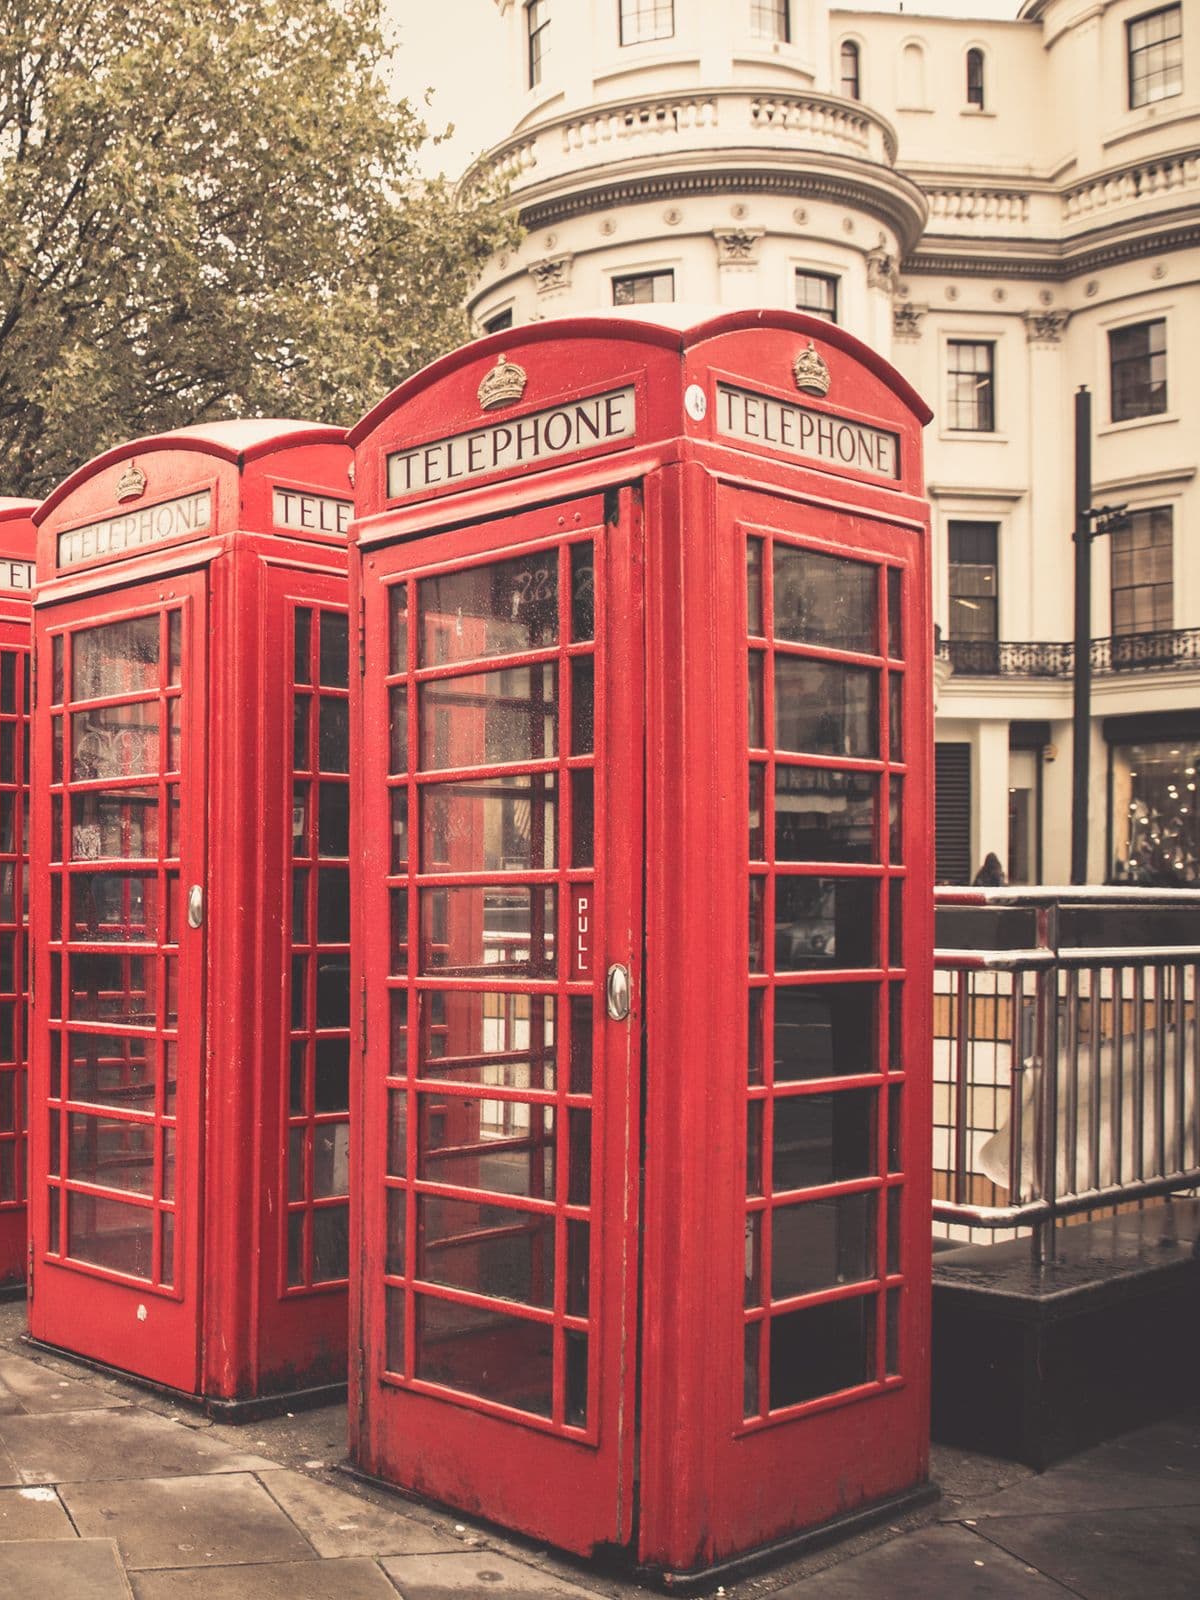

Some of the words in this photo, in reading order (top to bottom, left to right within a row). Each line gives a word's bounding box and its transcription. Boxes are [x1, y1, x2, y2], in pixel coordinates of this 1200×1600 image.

[397, 394, 626, 490] TELEPHONE
[720, 389, 889, 473] TELEPHONE
[65, 495, 208, 562] TELEPHONE
[275, 492, 350, 534] TELE
[578, 898, 588, 970] PULL
